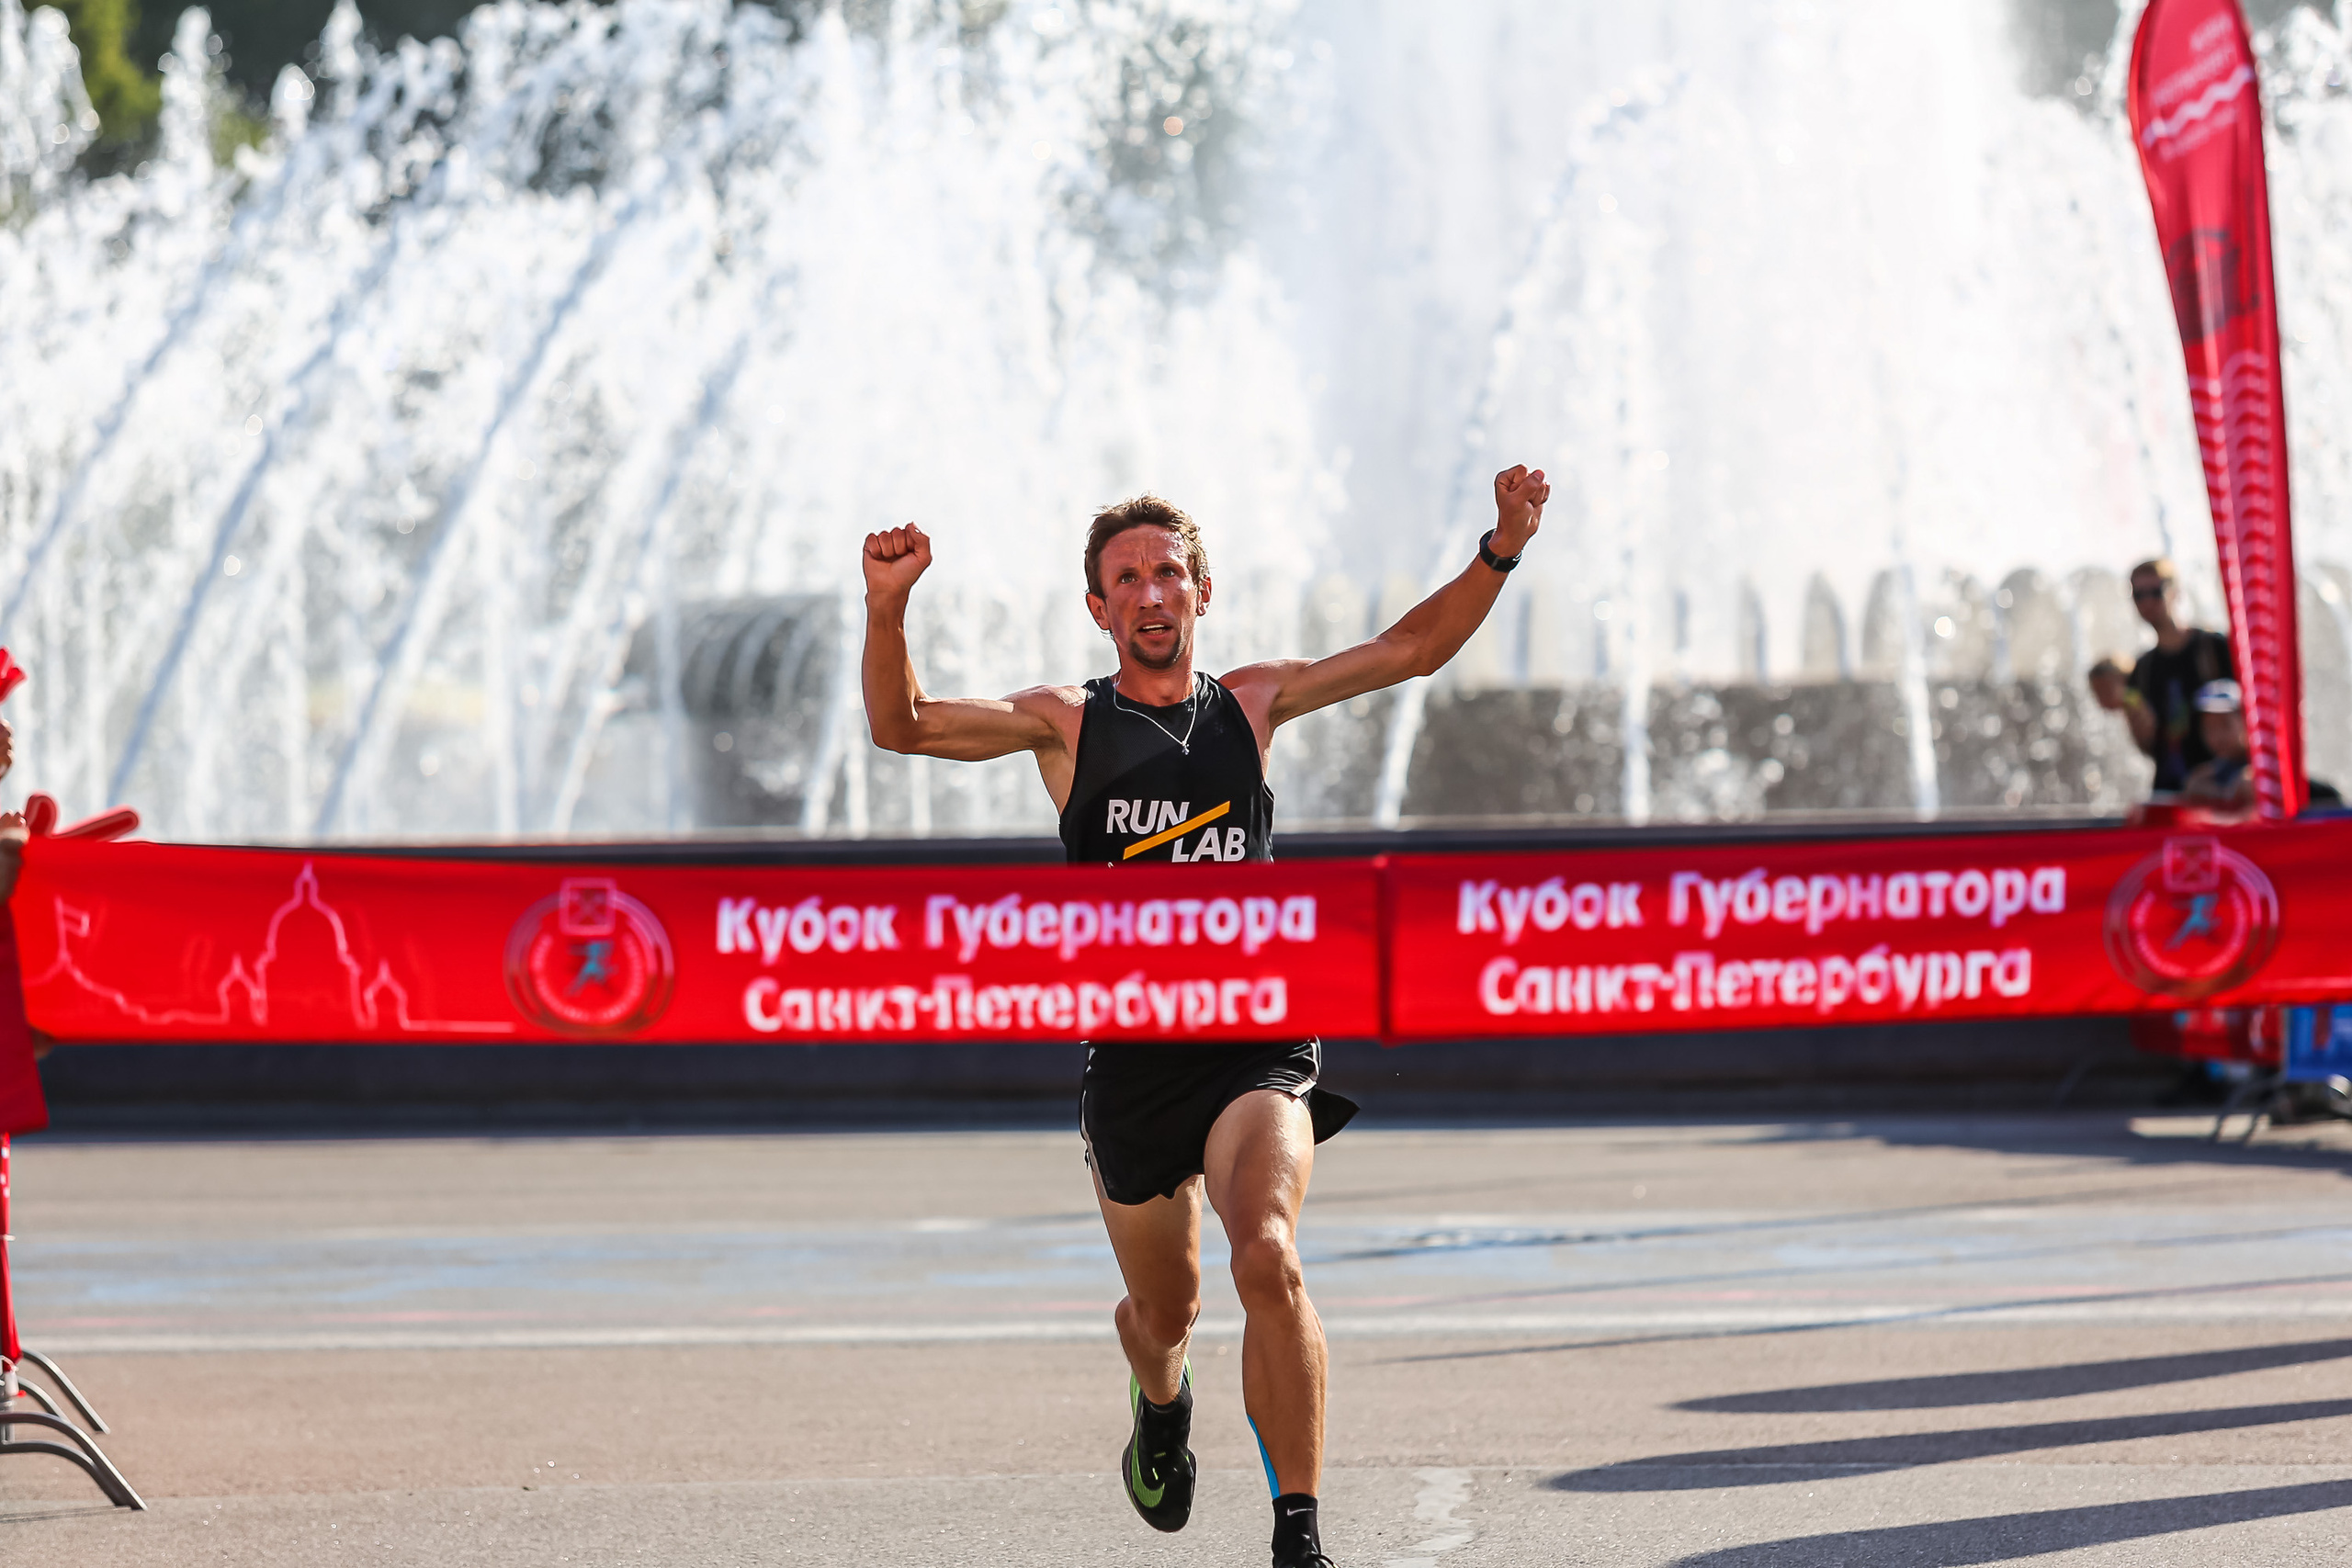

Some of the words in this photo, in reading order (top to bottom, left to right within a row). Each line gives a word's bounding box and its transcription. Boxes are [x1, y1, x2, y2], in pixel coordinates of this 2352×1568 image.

[1106, 799, 1190, 834] RUN
[1171, 828, 1246, 863] LAB
[717, 897, 899, 964] Кубок
[925, 894, 1317, 962] Губернатора
[1457, 877, 1643, 944] Кубок
[1668, 867, 2065, 938] Губернатора
[744, 973, 1287, 1033] Санкт-Петербурга
[1480, 945, 2031, 1015] Санкт-Петербурга
